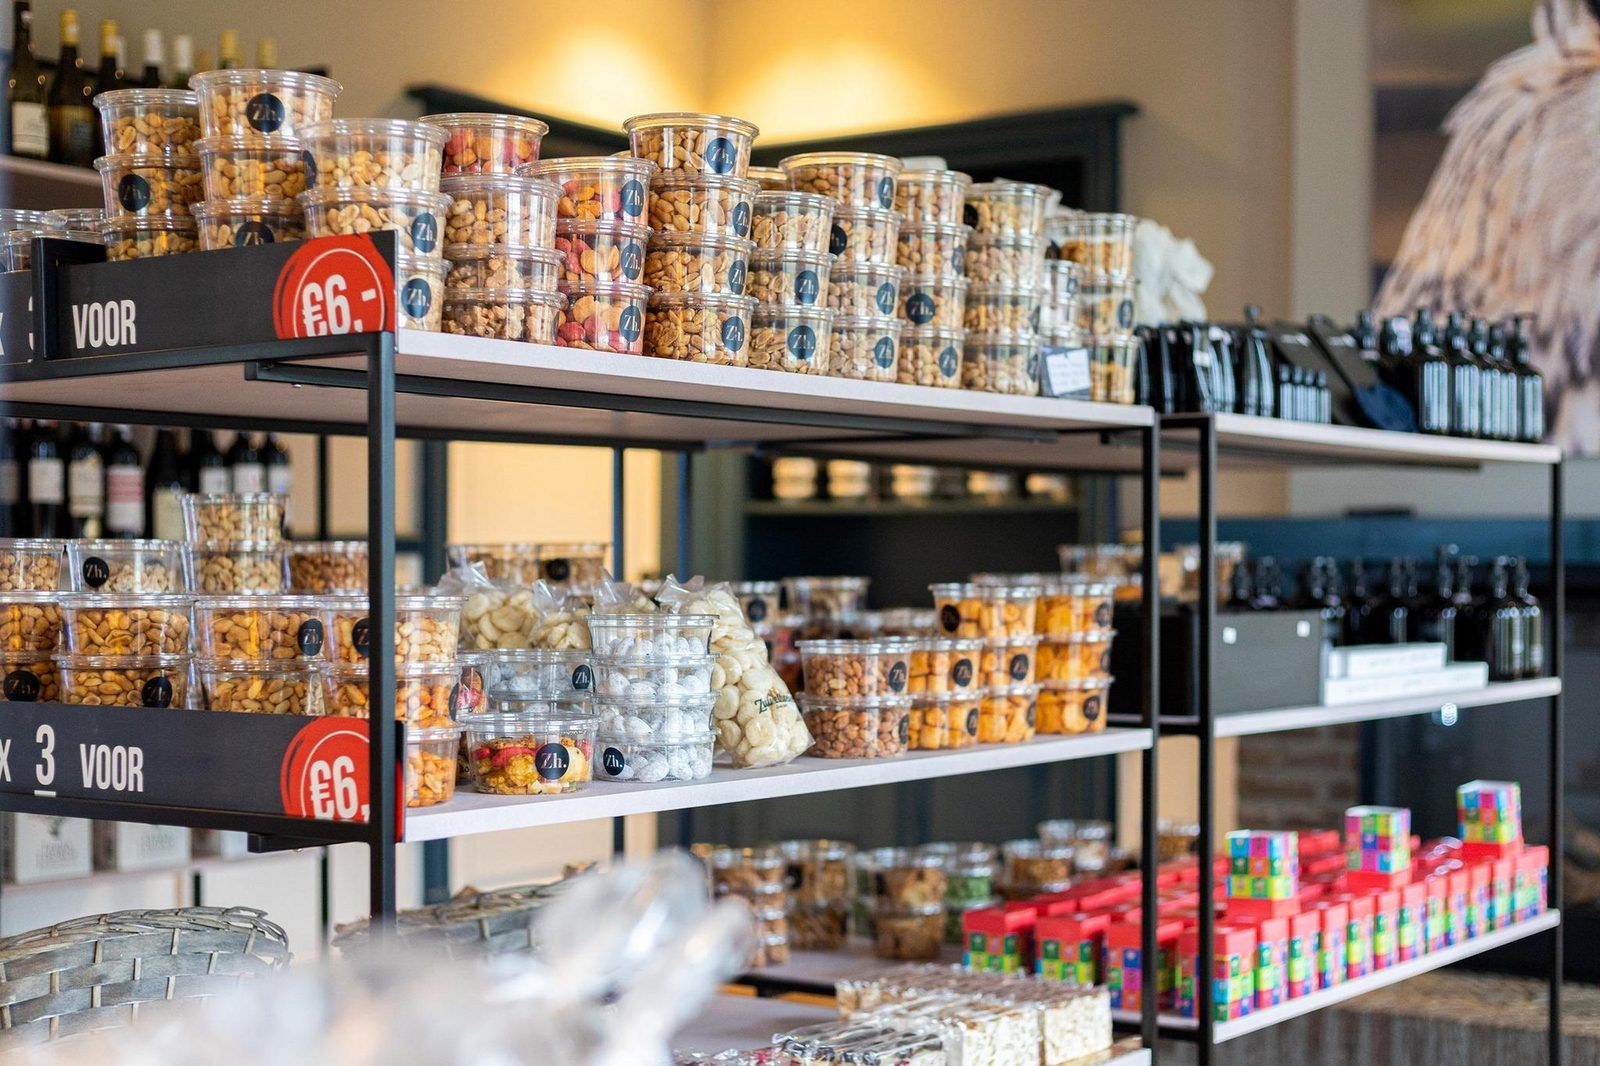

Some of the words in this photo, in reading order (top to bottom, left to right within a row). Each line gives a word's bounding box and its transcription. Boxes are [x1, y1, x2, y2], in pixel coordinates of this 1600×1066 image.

[711, 146, 733, 163] Zh.
[626, 189, 643, 206] Zh.
[416, 222, 438, 245] Zh.
[624, 252, 641, 270] Zh.
[799, 278, 818, 295] Zh.
[407, 288, 430, 307] Zh.
[910, 302, 933, 316] Zh.
[72, 299, 136, 349] VOOR
[624, 315, 640, 331] Zh.
[725, 325, 743, 342] Zh.
[792, 334, 815, 350] Zh.
[85, 563, 107, 579] Zh.
[303, 628, 322, 645] Zh.
[575, 671, 590, 685] Zh.
[35, 724, 56, 786] 3
[79, 743, 144, 792] VOOR
[540, 753, 567, 769] Zh.
[605, 755, 623, 768] Zh.
[309, 755, 370, 823] €6,
